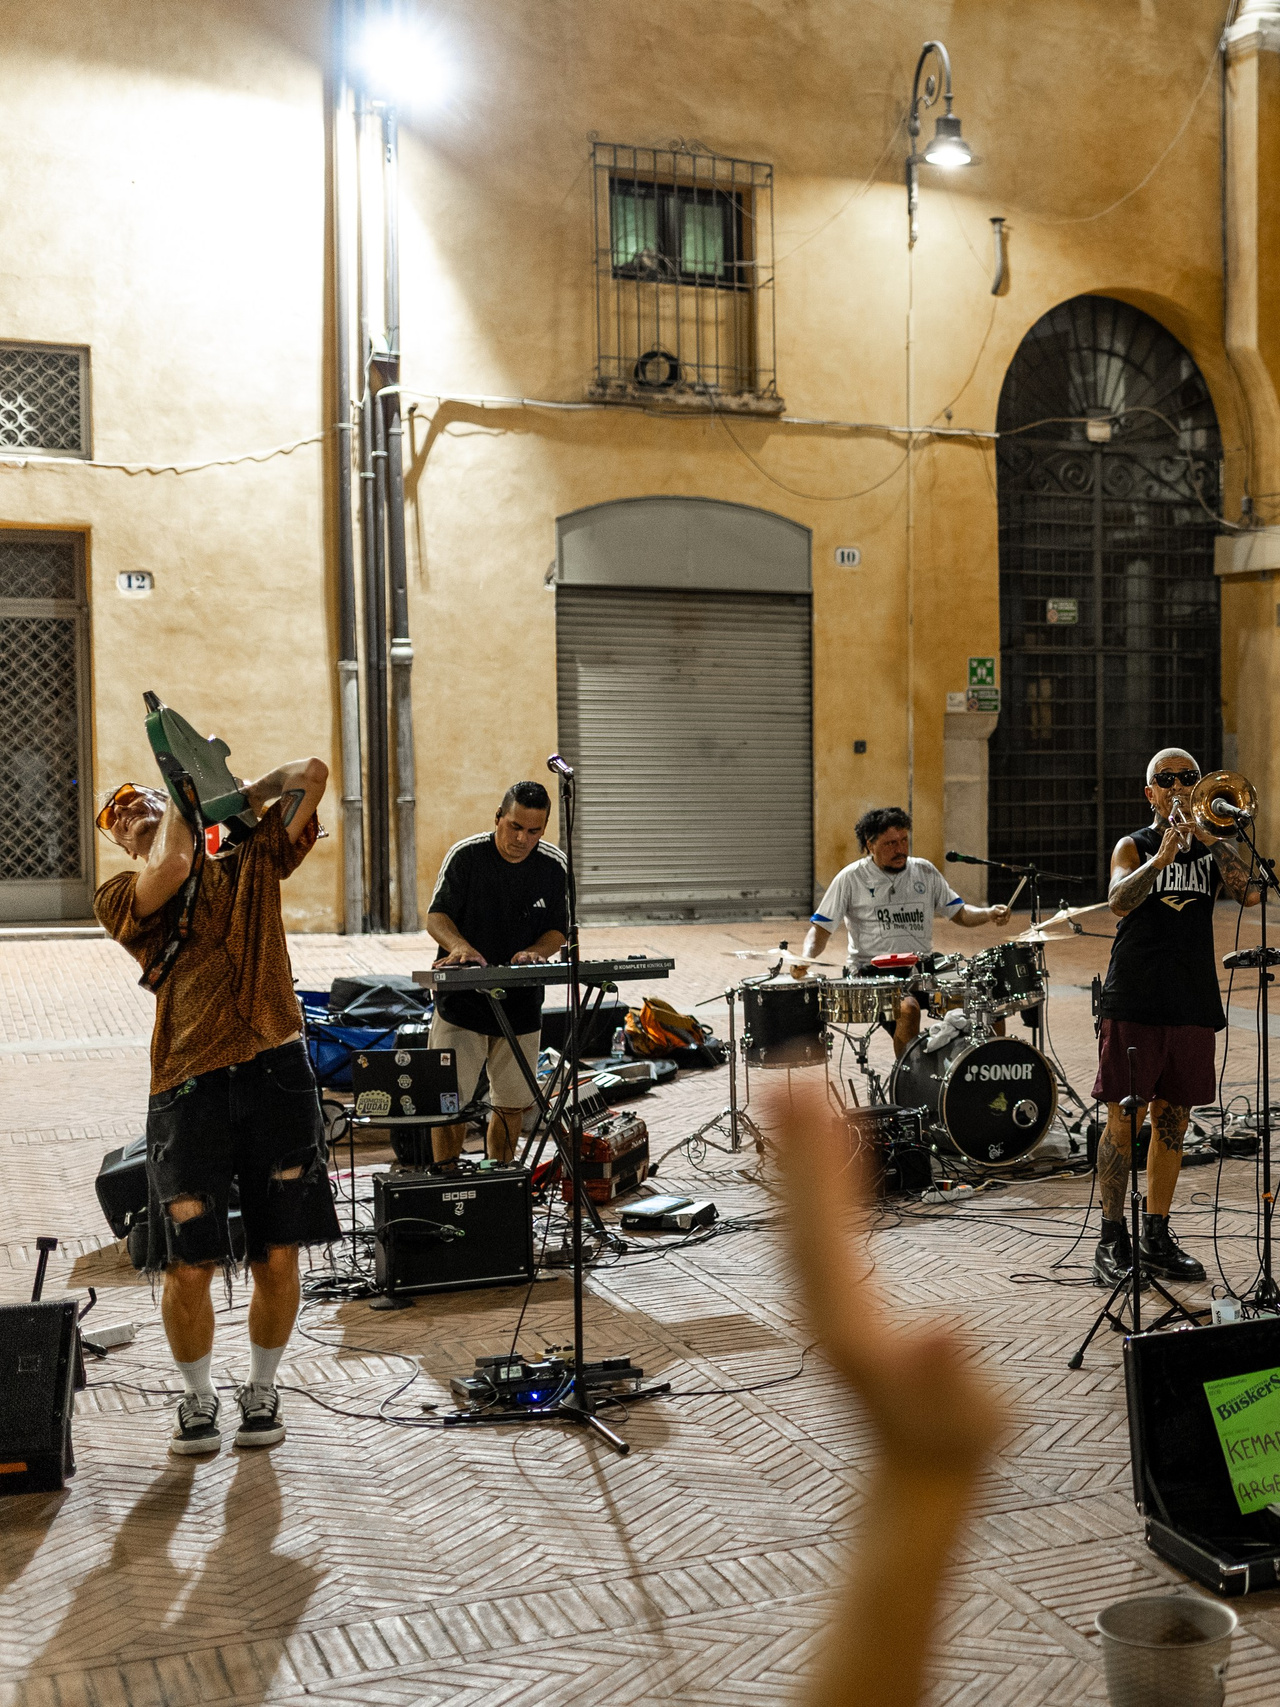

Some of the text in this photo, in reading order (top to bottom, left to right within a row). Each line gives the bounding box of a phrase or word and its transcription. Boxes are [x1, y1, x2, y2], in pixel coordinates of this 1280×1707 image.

[840, 550, 856, 564] 10
[127, 574, 146, 589] 12
[1145, 853, 1213, 897] VERLAST
[979, 1064, 1033, 1081] SONOR
[358, 1103, 389, 1111] CIUDAD
[442, 1190, 476, 1201] BOSS
